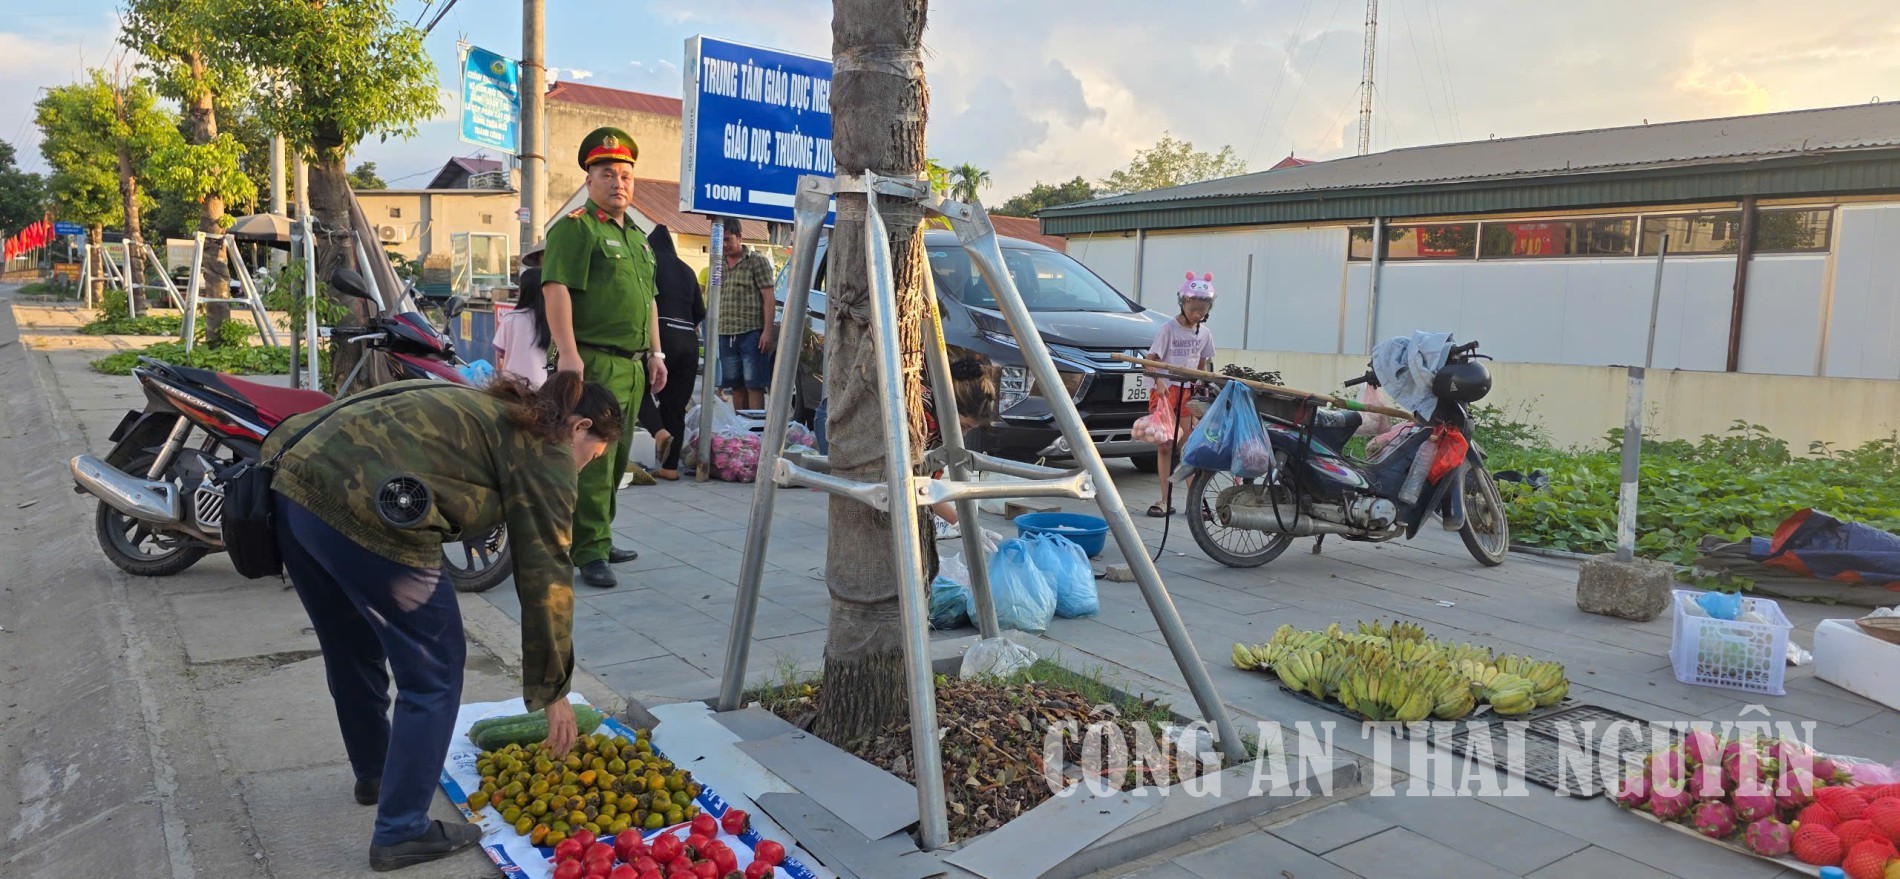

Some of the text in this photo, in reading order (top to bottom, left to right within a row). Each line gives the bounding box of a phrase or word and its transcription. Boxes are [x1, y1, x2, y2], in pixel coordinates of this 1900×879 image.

[703, 56, 738, 98] TRUNG
[741, 58, 763, 102] TÂM
[764, 64, 788, 107] GIÁO
[789, 73, 810, 115] DỤC
[724, 118, 749, 161] GIÁO
[750, 127, 771, 170] DỤC
[775, 125, 814, 171] THƯỜNG
[704, 183, 742, 202] 100M
